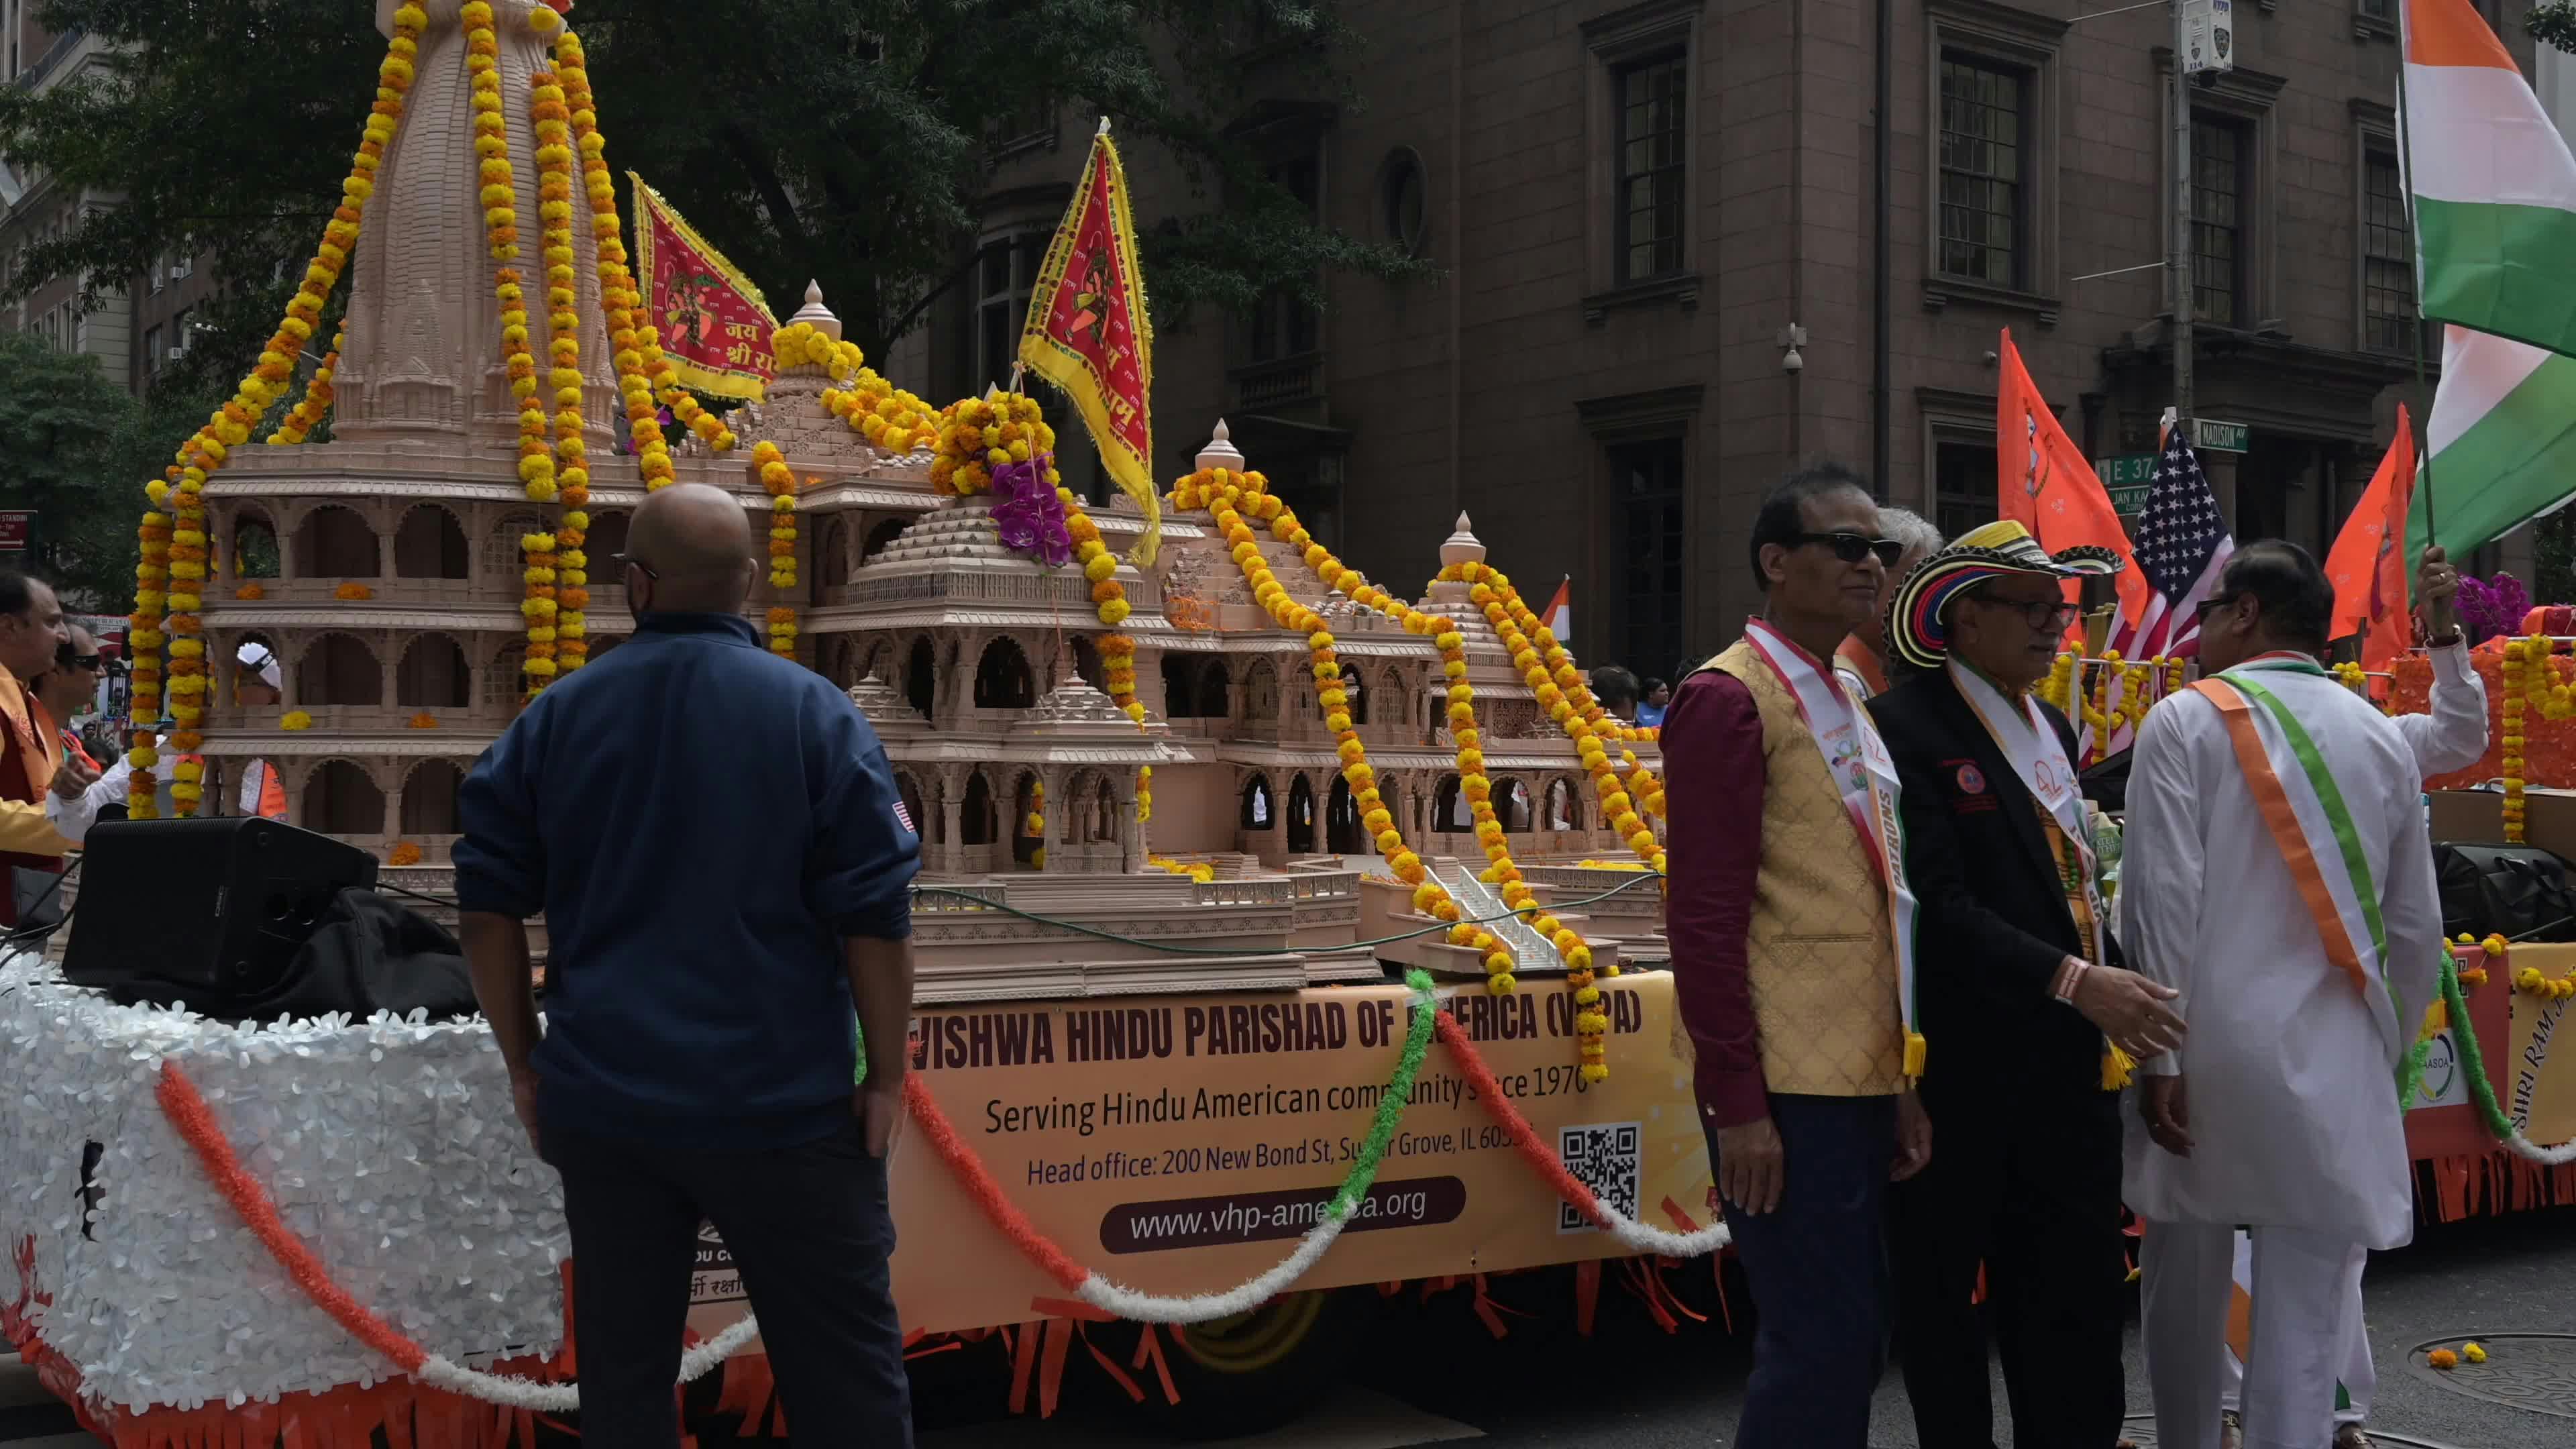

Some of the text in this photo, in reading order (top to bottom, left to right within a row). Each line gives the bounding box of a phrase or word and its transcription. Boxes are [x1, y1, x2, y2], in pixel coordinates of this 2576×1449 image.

[724, 321, 759, 342] जय
[726, 342, 753, 365] श्री
[2203, 423, 2235, 446] MADISON
[2114, 458, 2153, 481] E 37
[2113, 492, 2130, 505] JAN
[1879, 788, 1906, 892] PATRONS
[1066, 1008, 1173, 1063] HINDU
[1185, 1002, 1346, 1057] PARISHAD
[1357, 1000, 1395, 1047] OF
[2510, 1008, 2555, 1130] SHRI RAM
[985, 1097, 1095, 1136] Serving
[1104, 1087, 1185, 1125] Hindu
[1192, 1084, 1320, 1120] American
[1027, 1157, 1085, 1185] Head
[1091, 1152, 1157, 1181] office:
[1162, 1148, 1200, 1176] 200
[1206, 1145, 1252, 1171] New
[1255, 1139, 1307, 1167] Bond
[1310, 1138, 1334, 1166] St,
[1339, 1137, 1395, 1161] Sur
[1399, 1132, 1456, 1155] Grove,
[1461, 1127, 1476, 1150] IL
